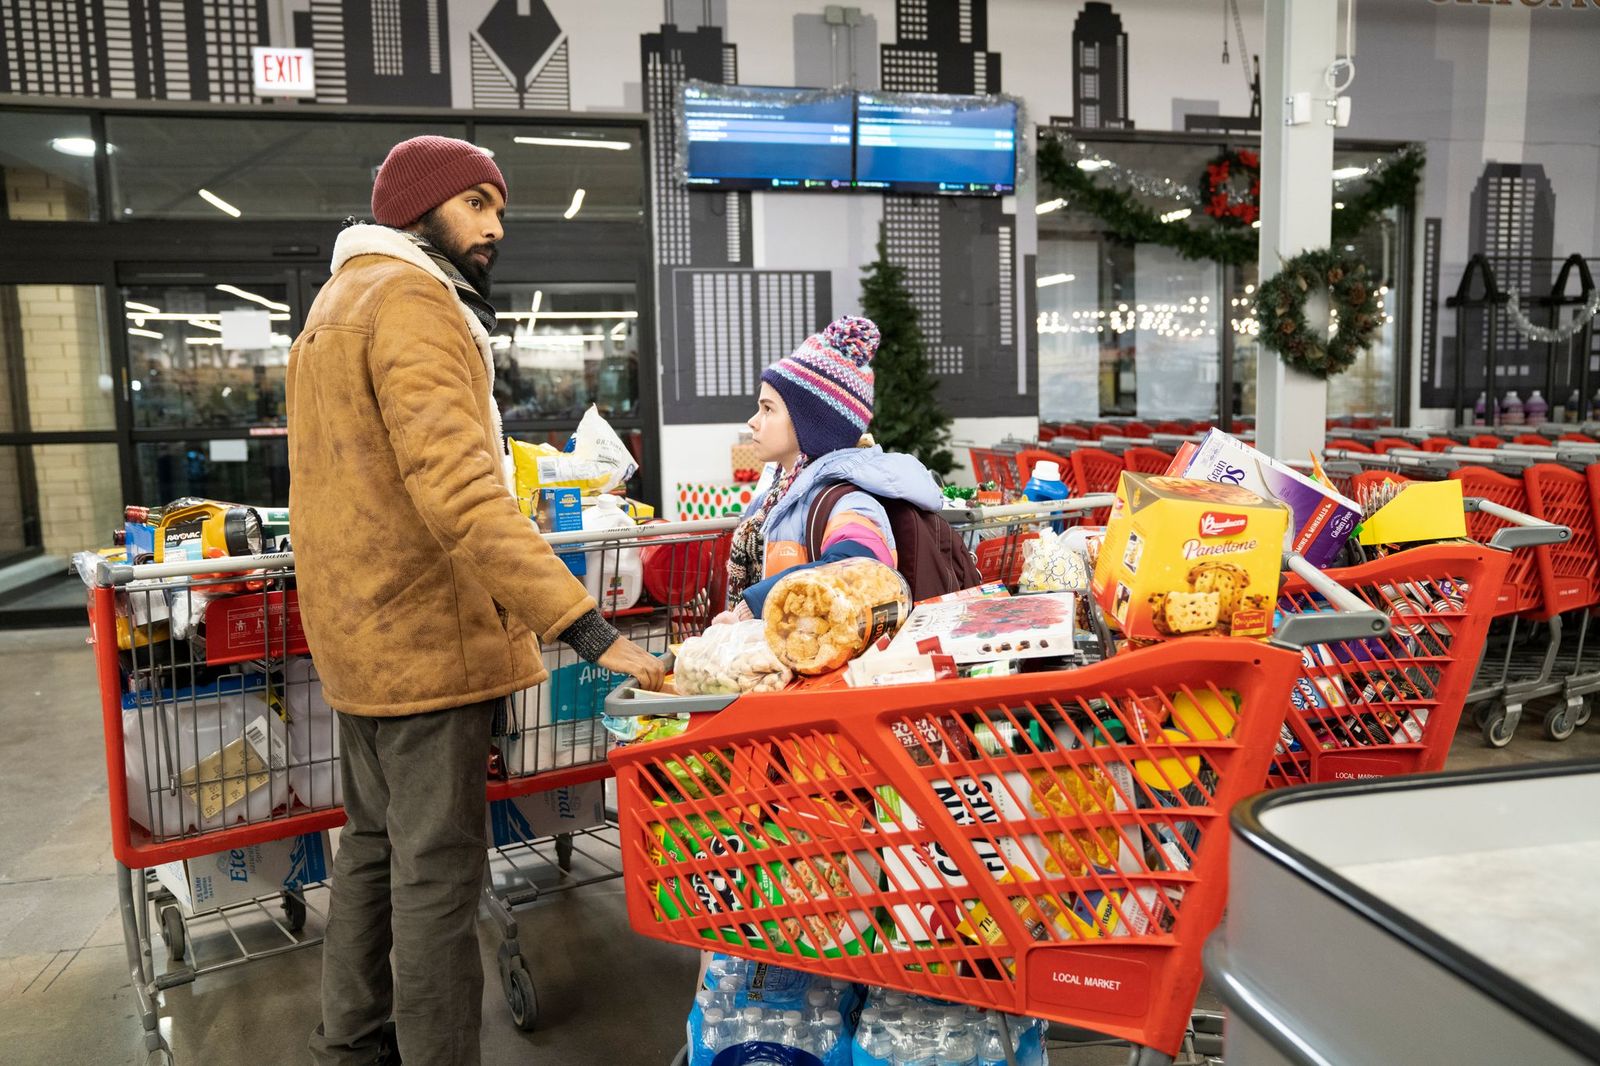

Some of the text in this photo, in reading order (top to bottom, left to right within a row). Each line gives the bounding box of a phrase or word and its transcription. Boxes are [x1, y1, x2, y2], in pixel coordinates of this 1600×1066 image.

[263, 55, 303, 82] EXIT
[1309, 507, 1329, 534] MINERALS
[1330, 511, 1354, 538] Gluten Free
[166, 532, 201, 541] RAYOVAC
[1183, 539, 1257, 561] Panettone
[1335, 772, 1356, 780] LOCAL
[1052, 972, 1122, 991] LOCAL MARKET
